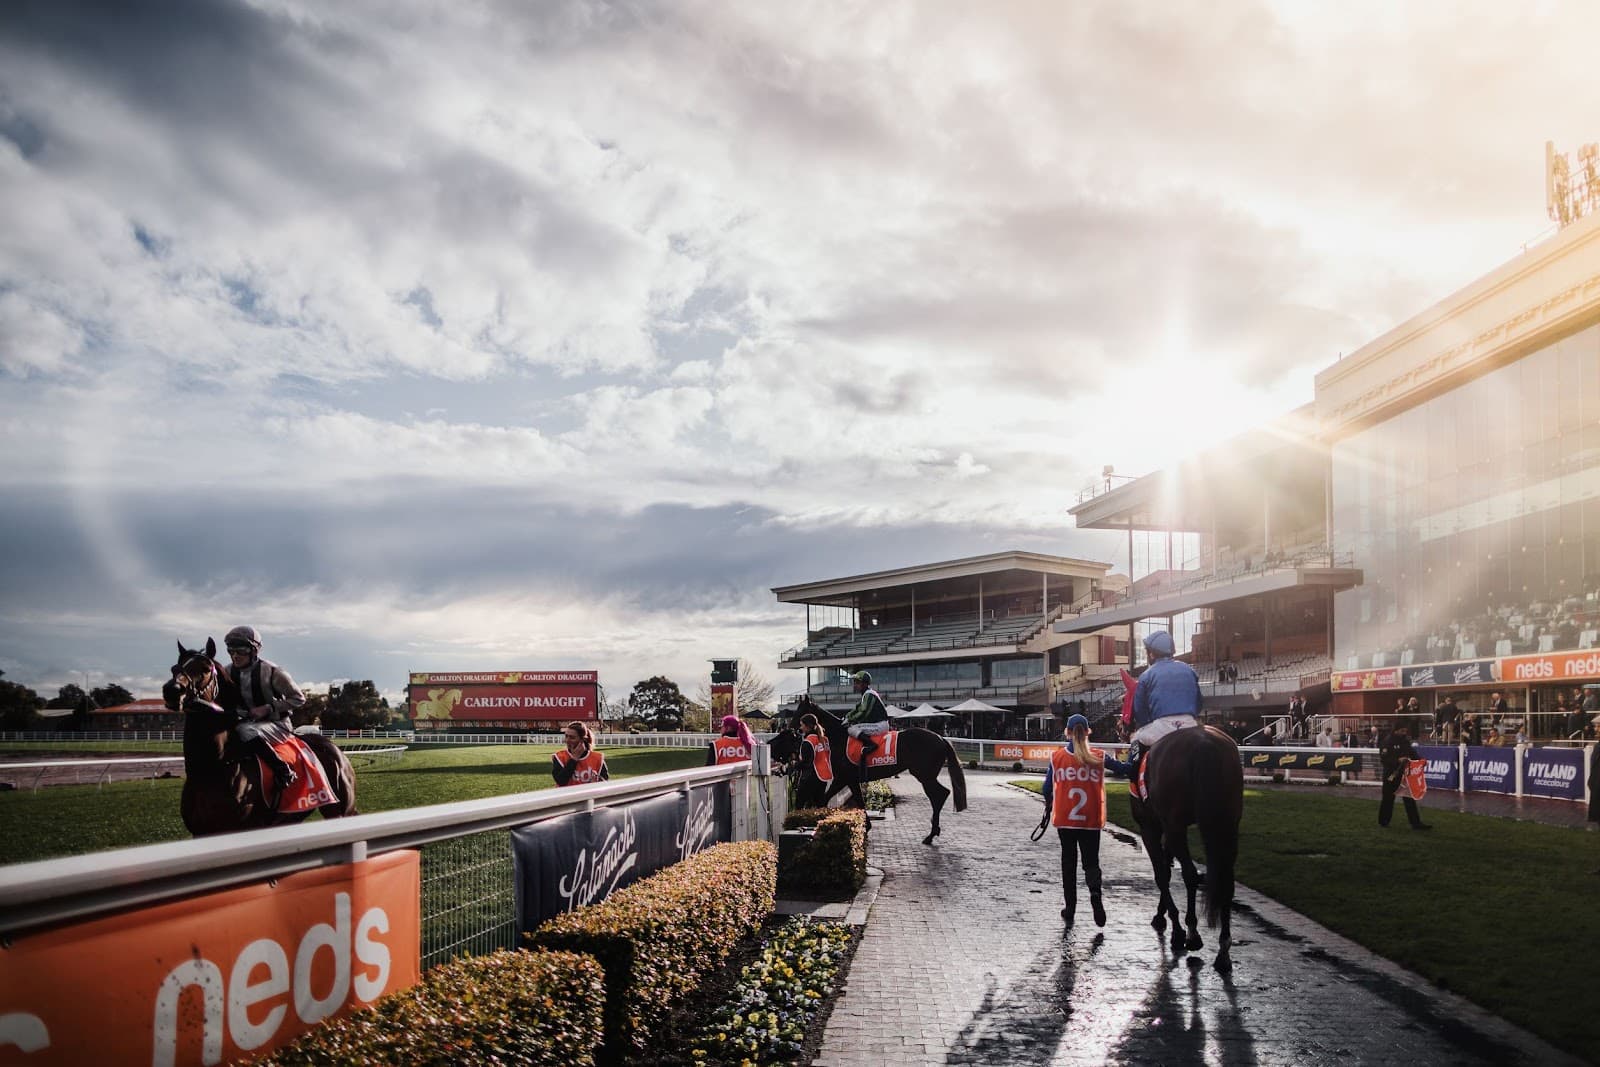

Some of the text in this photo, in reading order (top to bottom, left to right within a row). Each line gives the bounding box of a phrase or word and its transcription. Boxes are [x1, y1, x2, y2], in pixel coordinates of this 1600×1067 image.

[1516, 658, 1553, 679] neds
[464, 696, 586, 707] CARLTON DRAUGHT
[883, 734, 892, 754] 1
[1000, 746, 1023, 757] neds
[872, 756, 895, 764] neds
[1424, 760, 1451, 774] YLAND
[1468, 760, 1509, 776] HYLAND
[1056, 765, 1100, 782] neds
[1528, 762, 1576, 780] HYLAND
[297, 788, 330, 809] ned
[1068, 787, 1088, 821] 2
[152, 892, 391, 1067] neds
